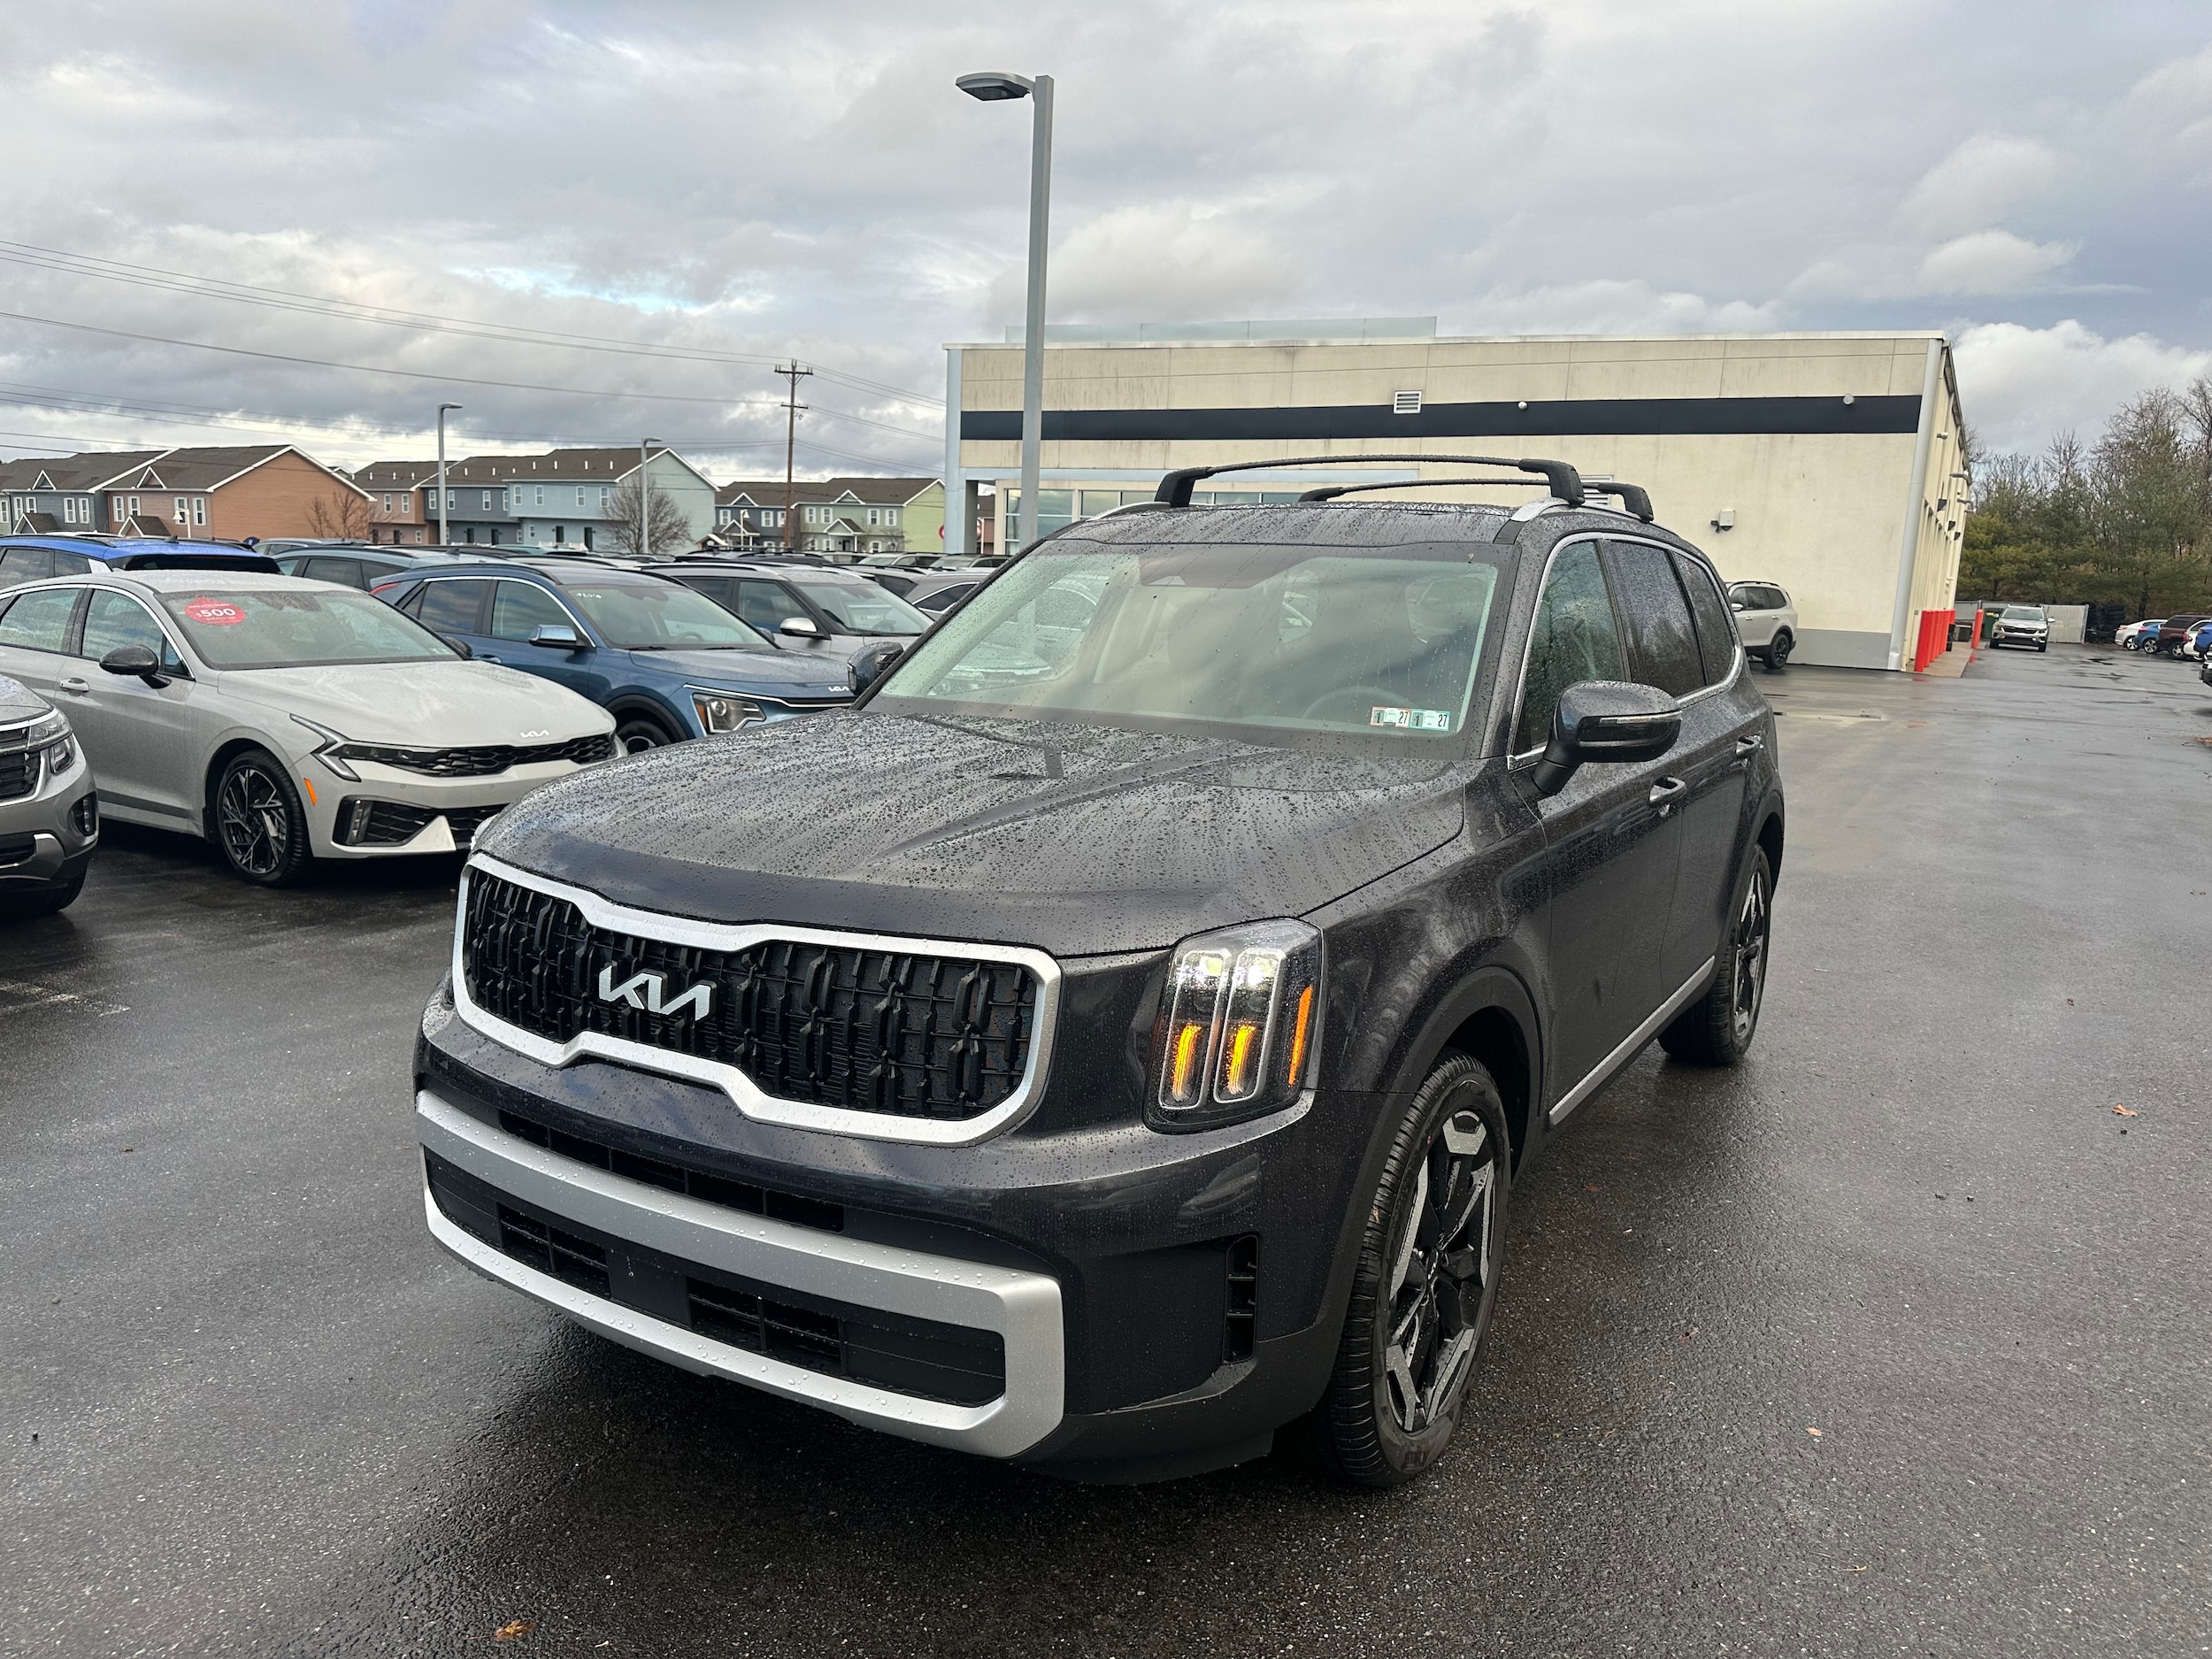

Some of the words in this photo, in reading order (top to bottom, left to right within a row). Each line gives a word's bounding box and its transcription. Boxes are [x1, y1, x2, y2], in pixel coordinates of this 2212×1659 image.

[1398, 710, 1409, 725] 27
[1437, 713, 1448, 728] 27
[598, 964, 712, 1022] KIA
